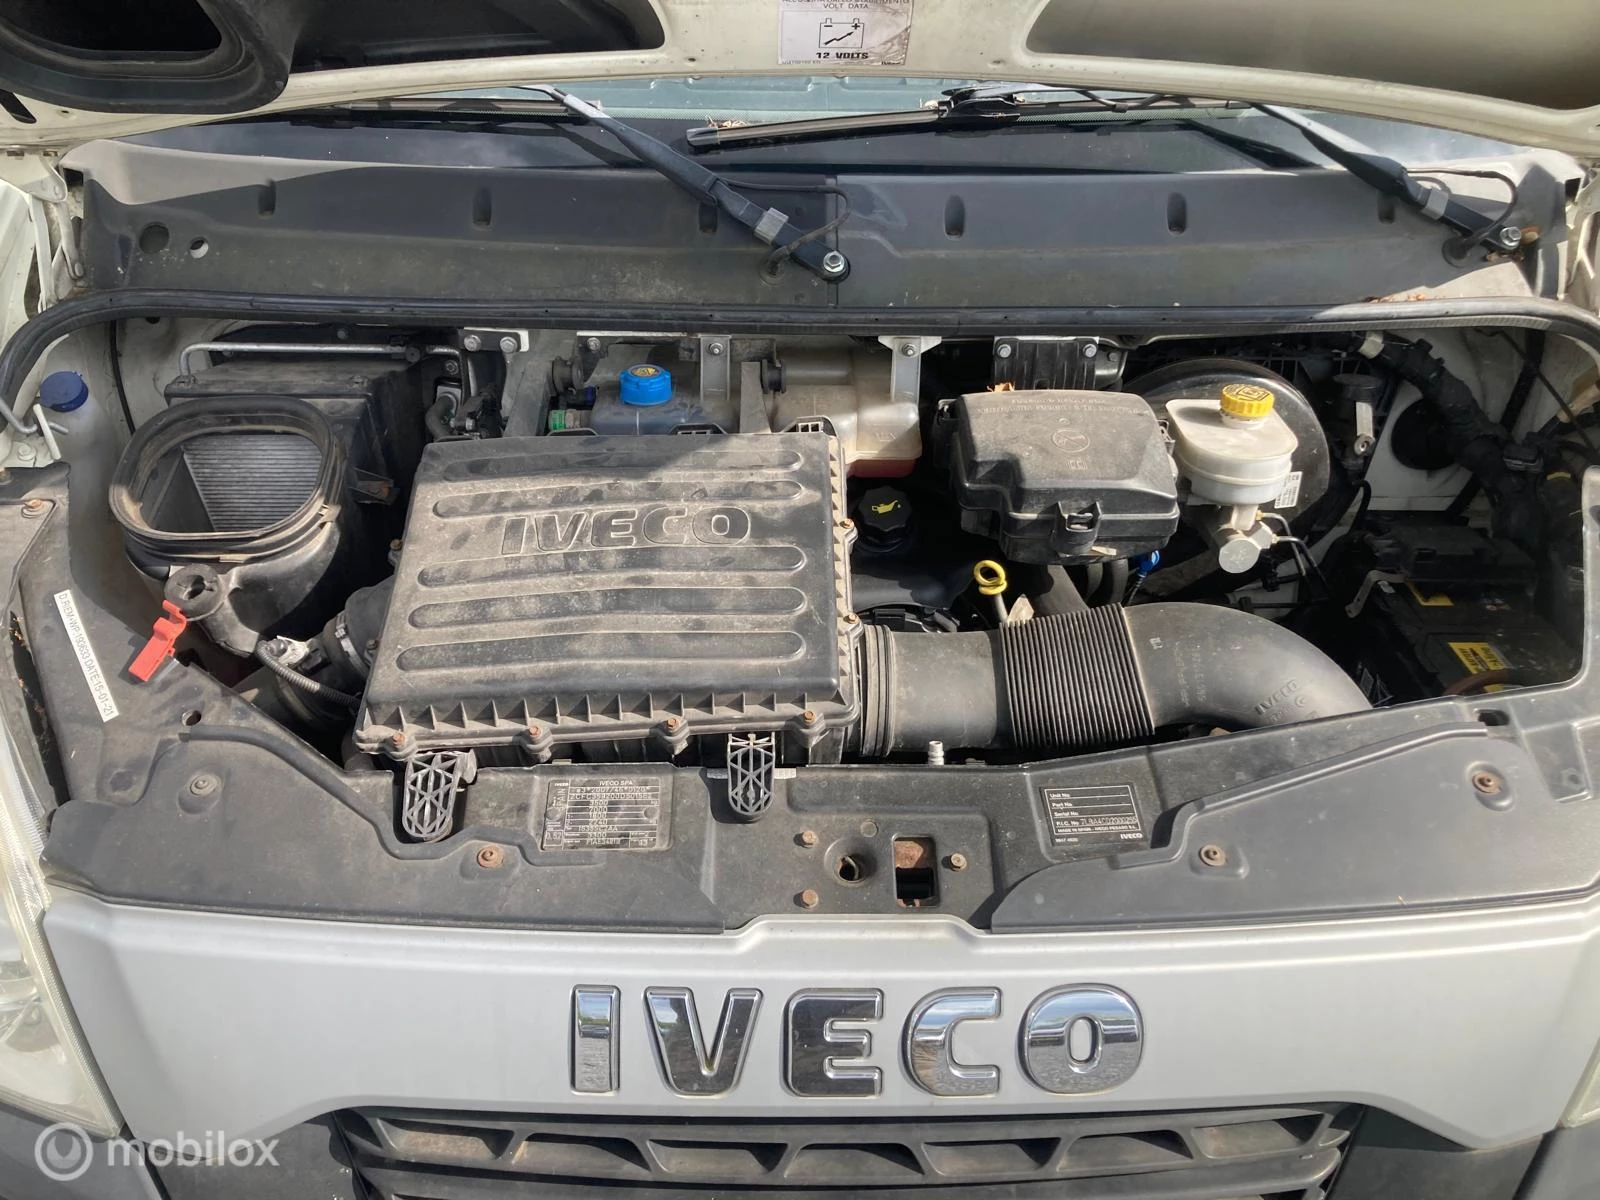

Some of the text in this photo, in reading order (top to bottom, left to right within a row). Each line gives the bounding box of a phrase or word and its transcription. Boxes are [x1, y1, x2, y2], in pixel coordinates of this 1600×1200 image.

[501, 506, 751, 555] IVECO
[1120, 832, 1144, 840] IVECO
[568, 983, 1145, 1098] IVECO
